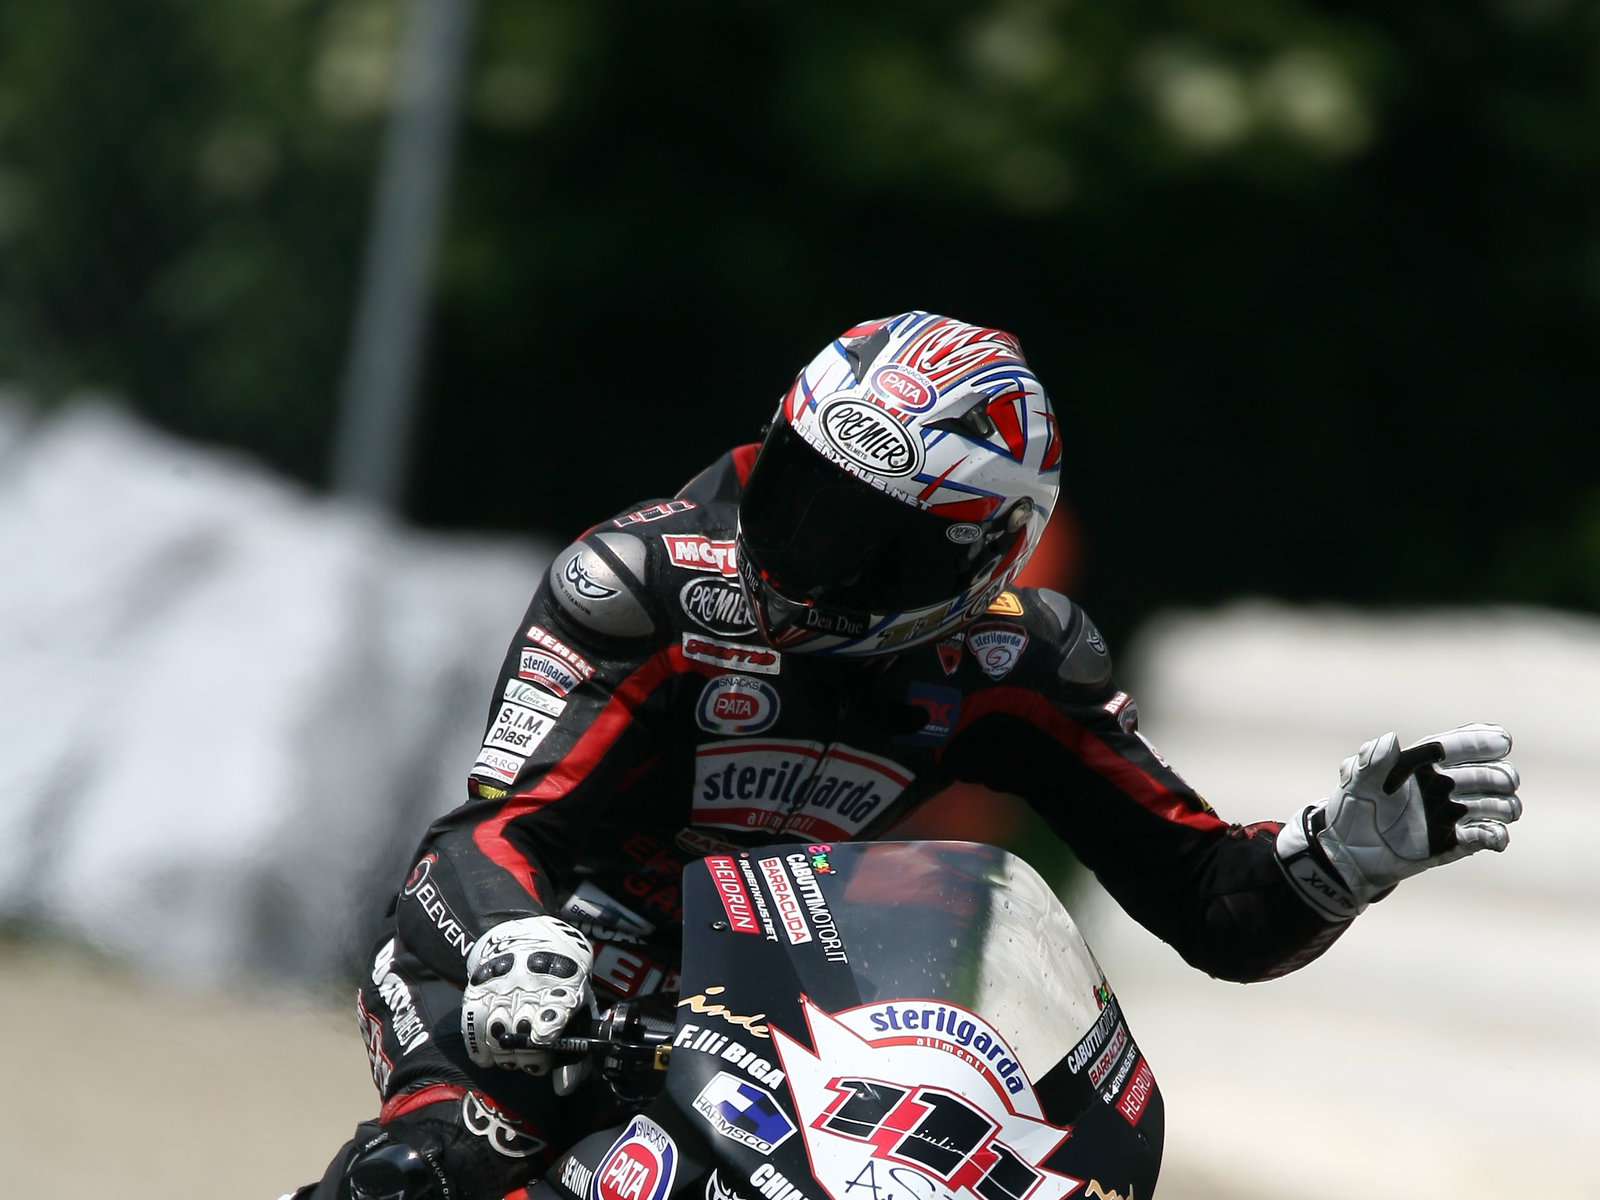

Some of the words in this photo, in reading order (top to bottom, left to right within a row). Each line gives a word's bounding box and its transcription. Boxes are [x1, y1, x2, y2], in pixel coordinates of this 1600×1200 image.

[882, 373, 922, 404] PATA
[828, 407, 909, 468] PREMIER
[807, 608, 835, 629] Dea
[836, 615, 864, 635] Due
[974, 632, 1021, 647] sterilgarda
[522, 655, 573, 689] sterilgarda
[719, 677, 759, 690] SNACKS
[500, 707, 544, 735] S.I.M.
[715, 698, 751, 715] PATA
[490, 726, 533, 748] plast
[484, 754, 519, 771] FARO
[703, 761, 881, 823] sterilgarda
[711, 859, 754, 929] HEIDRUN
[763, 859, 807, 942] BARRACUDA
[721, 1043, 786, 1090] BIGA
[870, 1005, 1024, 1095] sterilgarda
[916, 1037, 986, 1074] alimenti
[1121, 1063, 1154, 1120] HEIDRUN
[636, 1120, 667, 1152] SNACKS
[695, 1097, 773, 1153] HARMSCO
[561, 1155, 592, 1200] SENINI
